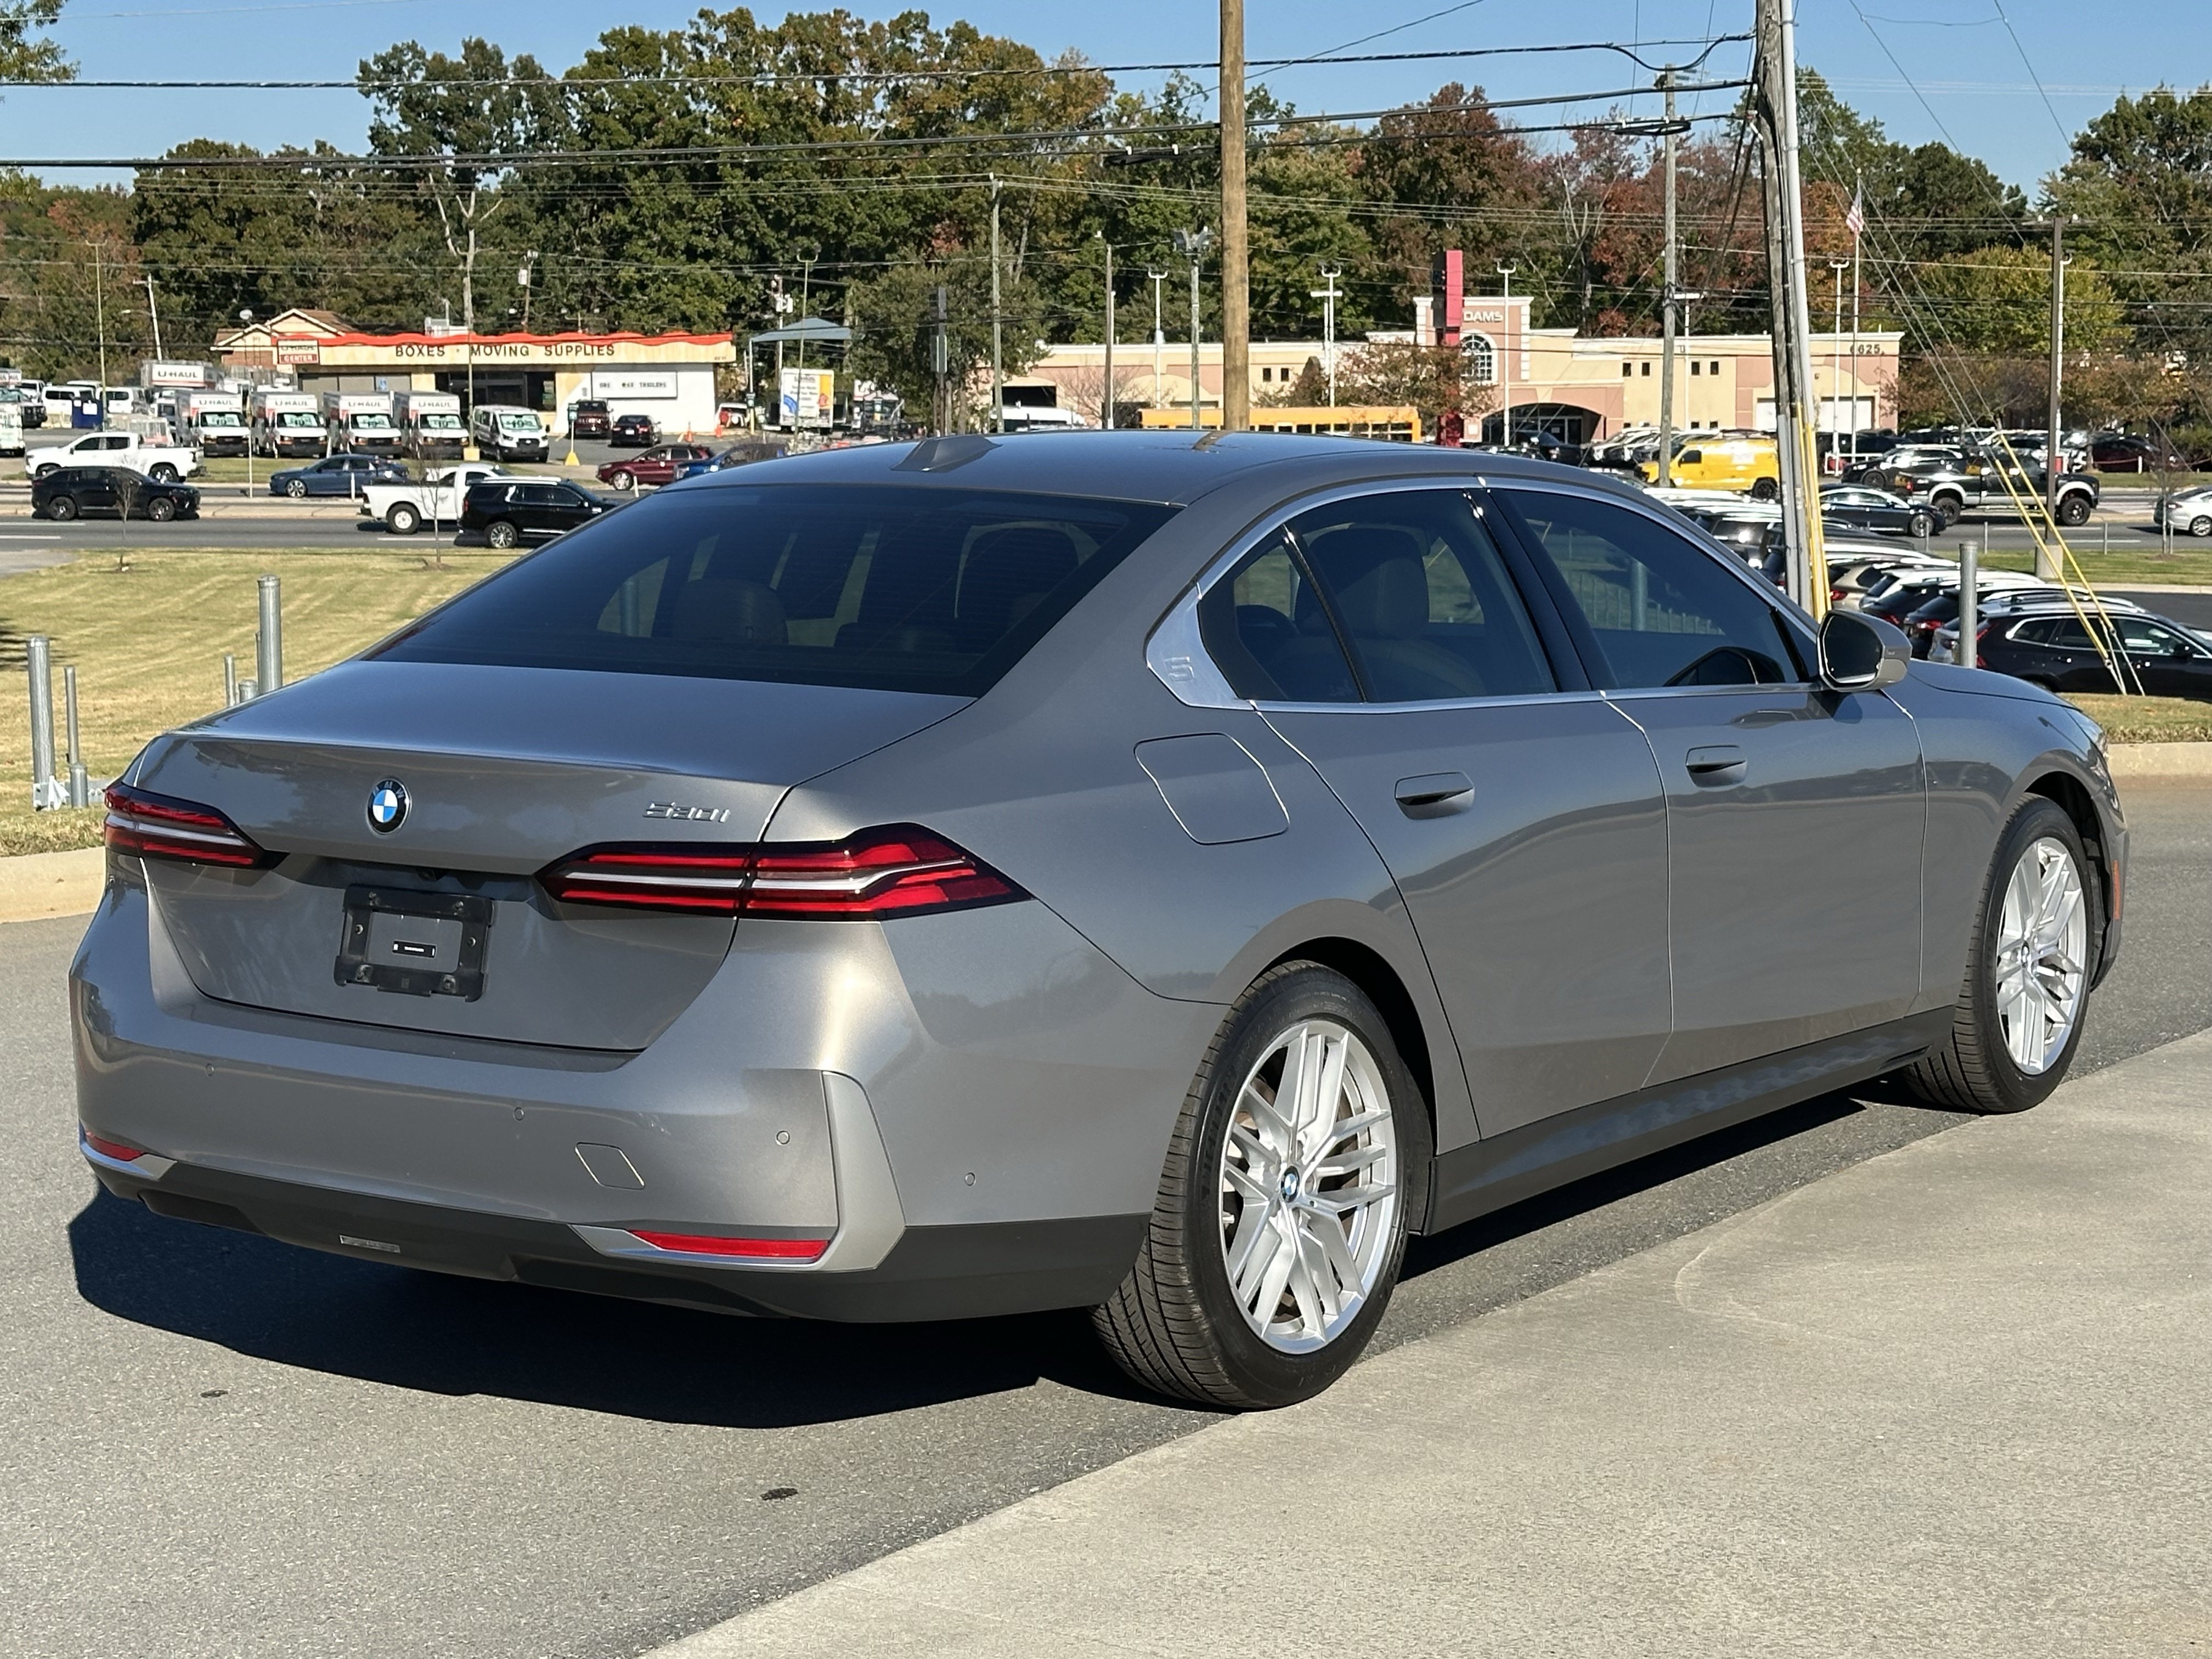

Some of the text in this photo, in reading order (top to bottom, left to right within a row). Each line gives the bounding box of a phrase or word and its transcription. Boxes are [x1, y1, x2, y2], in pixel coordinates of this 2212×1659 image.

[396, 344, 614, 357] BOXES MOVING SUPPLIES
